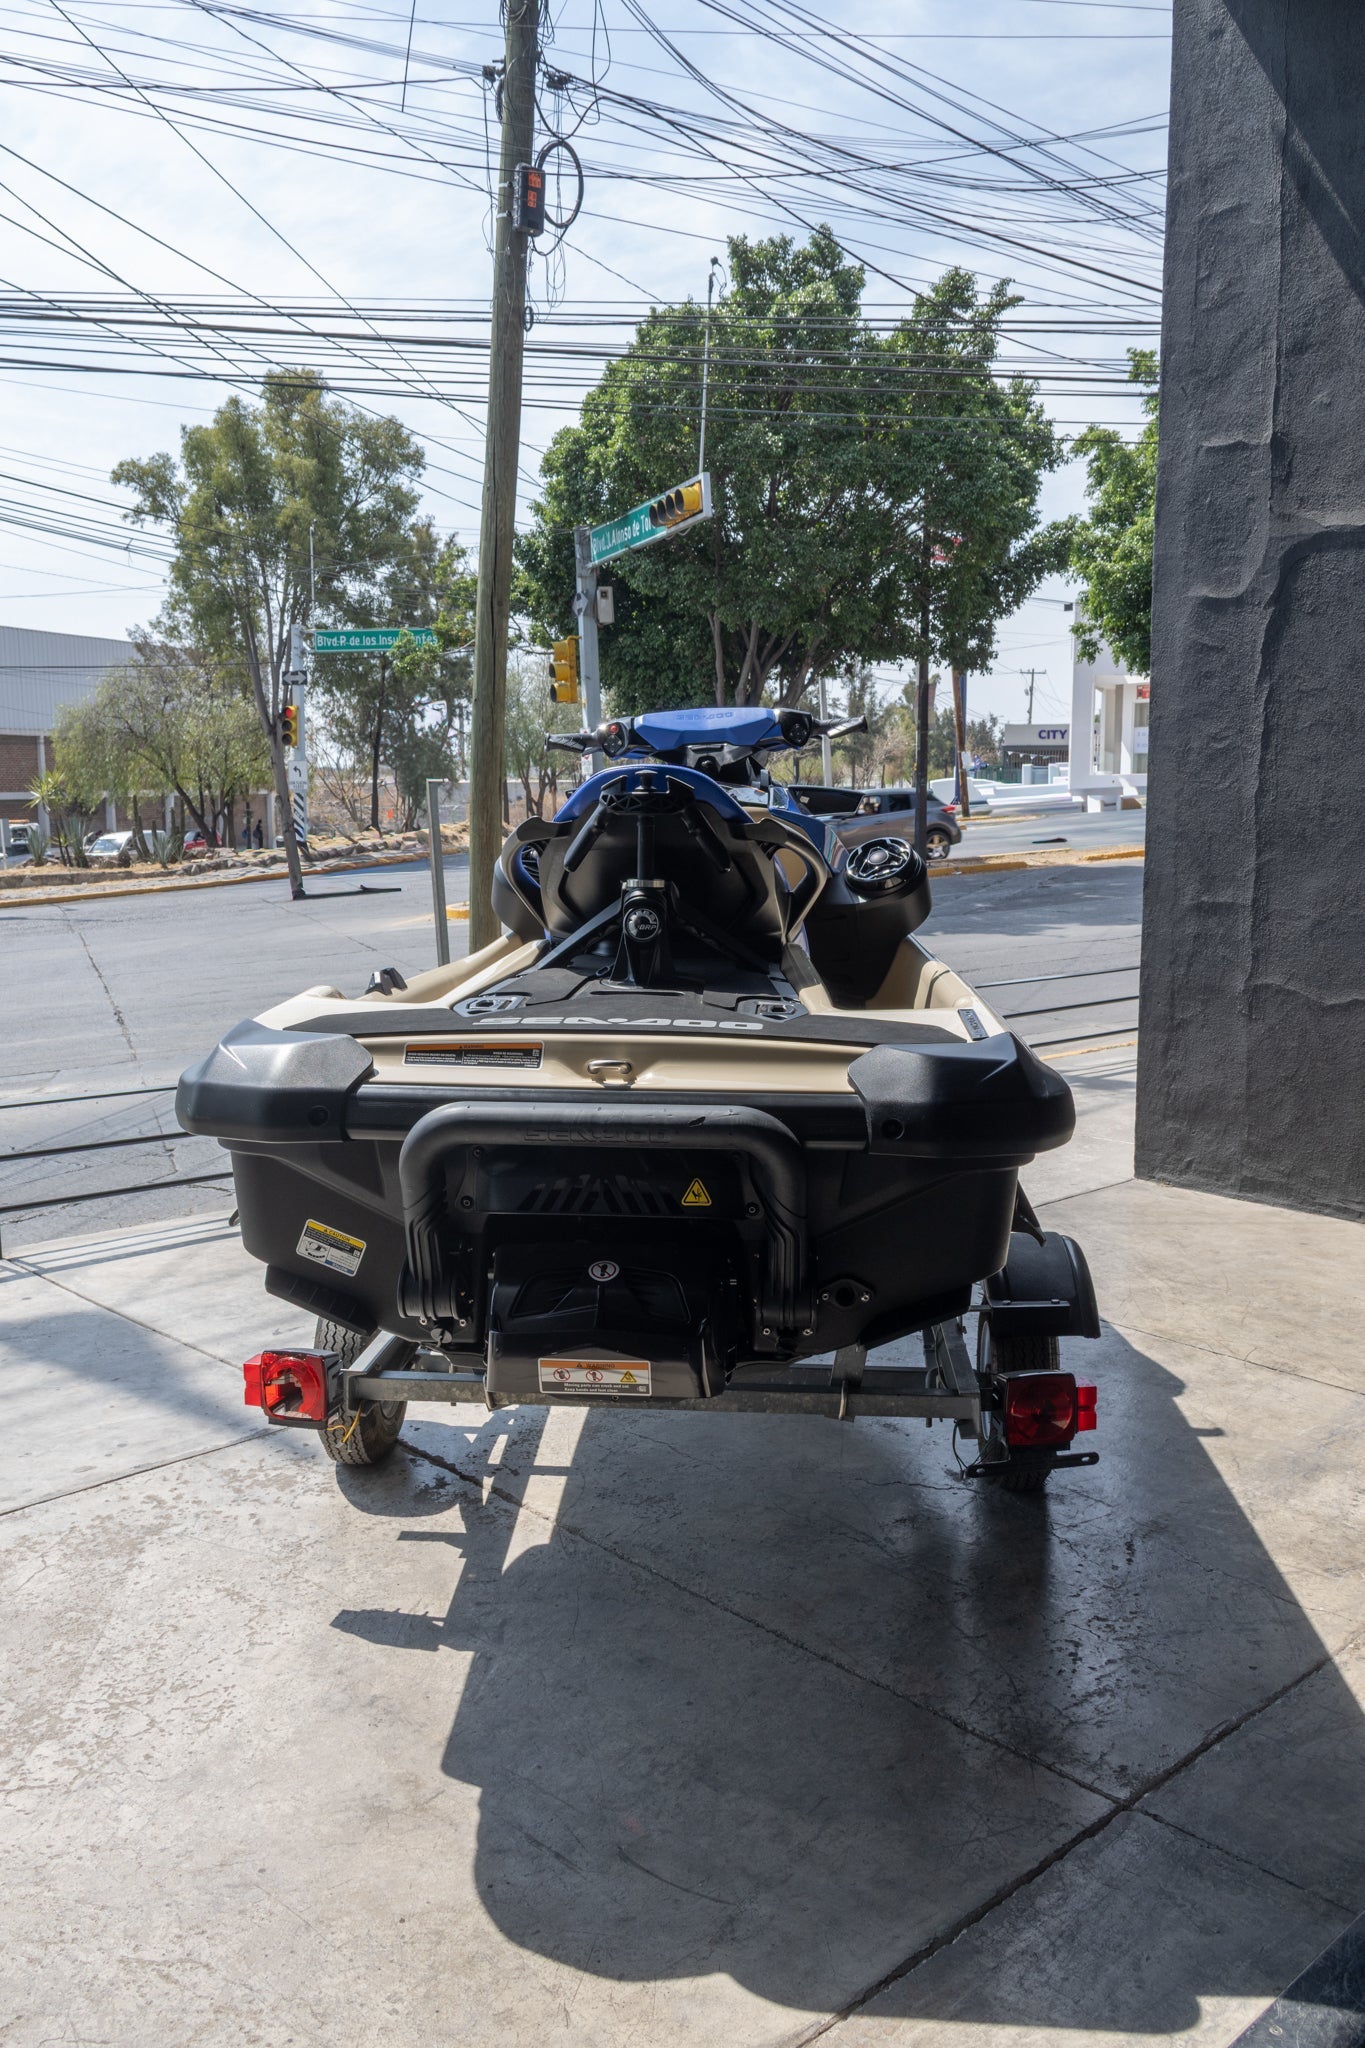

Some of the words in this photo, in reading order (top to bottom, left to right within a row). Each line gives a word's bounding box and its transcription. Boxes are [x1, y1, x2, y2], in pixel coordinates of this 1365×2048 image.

[632, 519, 640, 537] de
[349, 635, 360, 646] de
[363, 634, 377, 646] los
[1038, 729, 1068, 740] CITY
[328, 1229, 350, 1242] CAUTION
